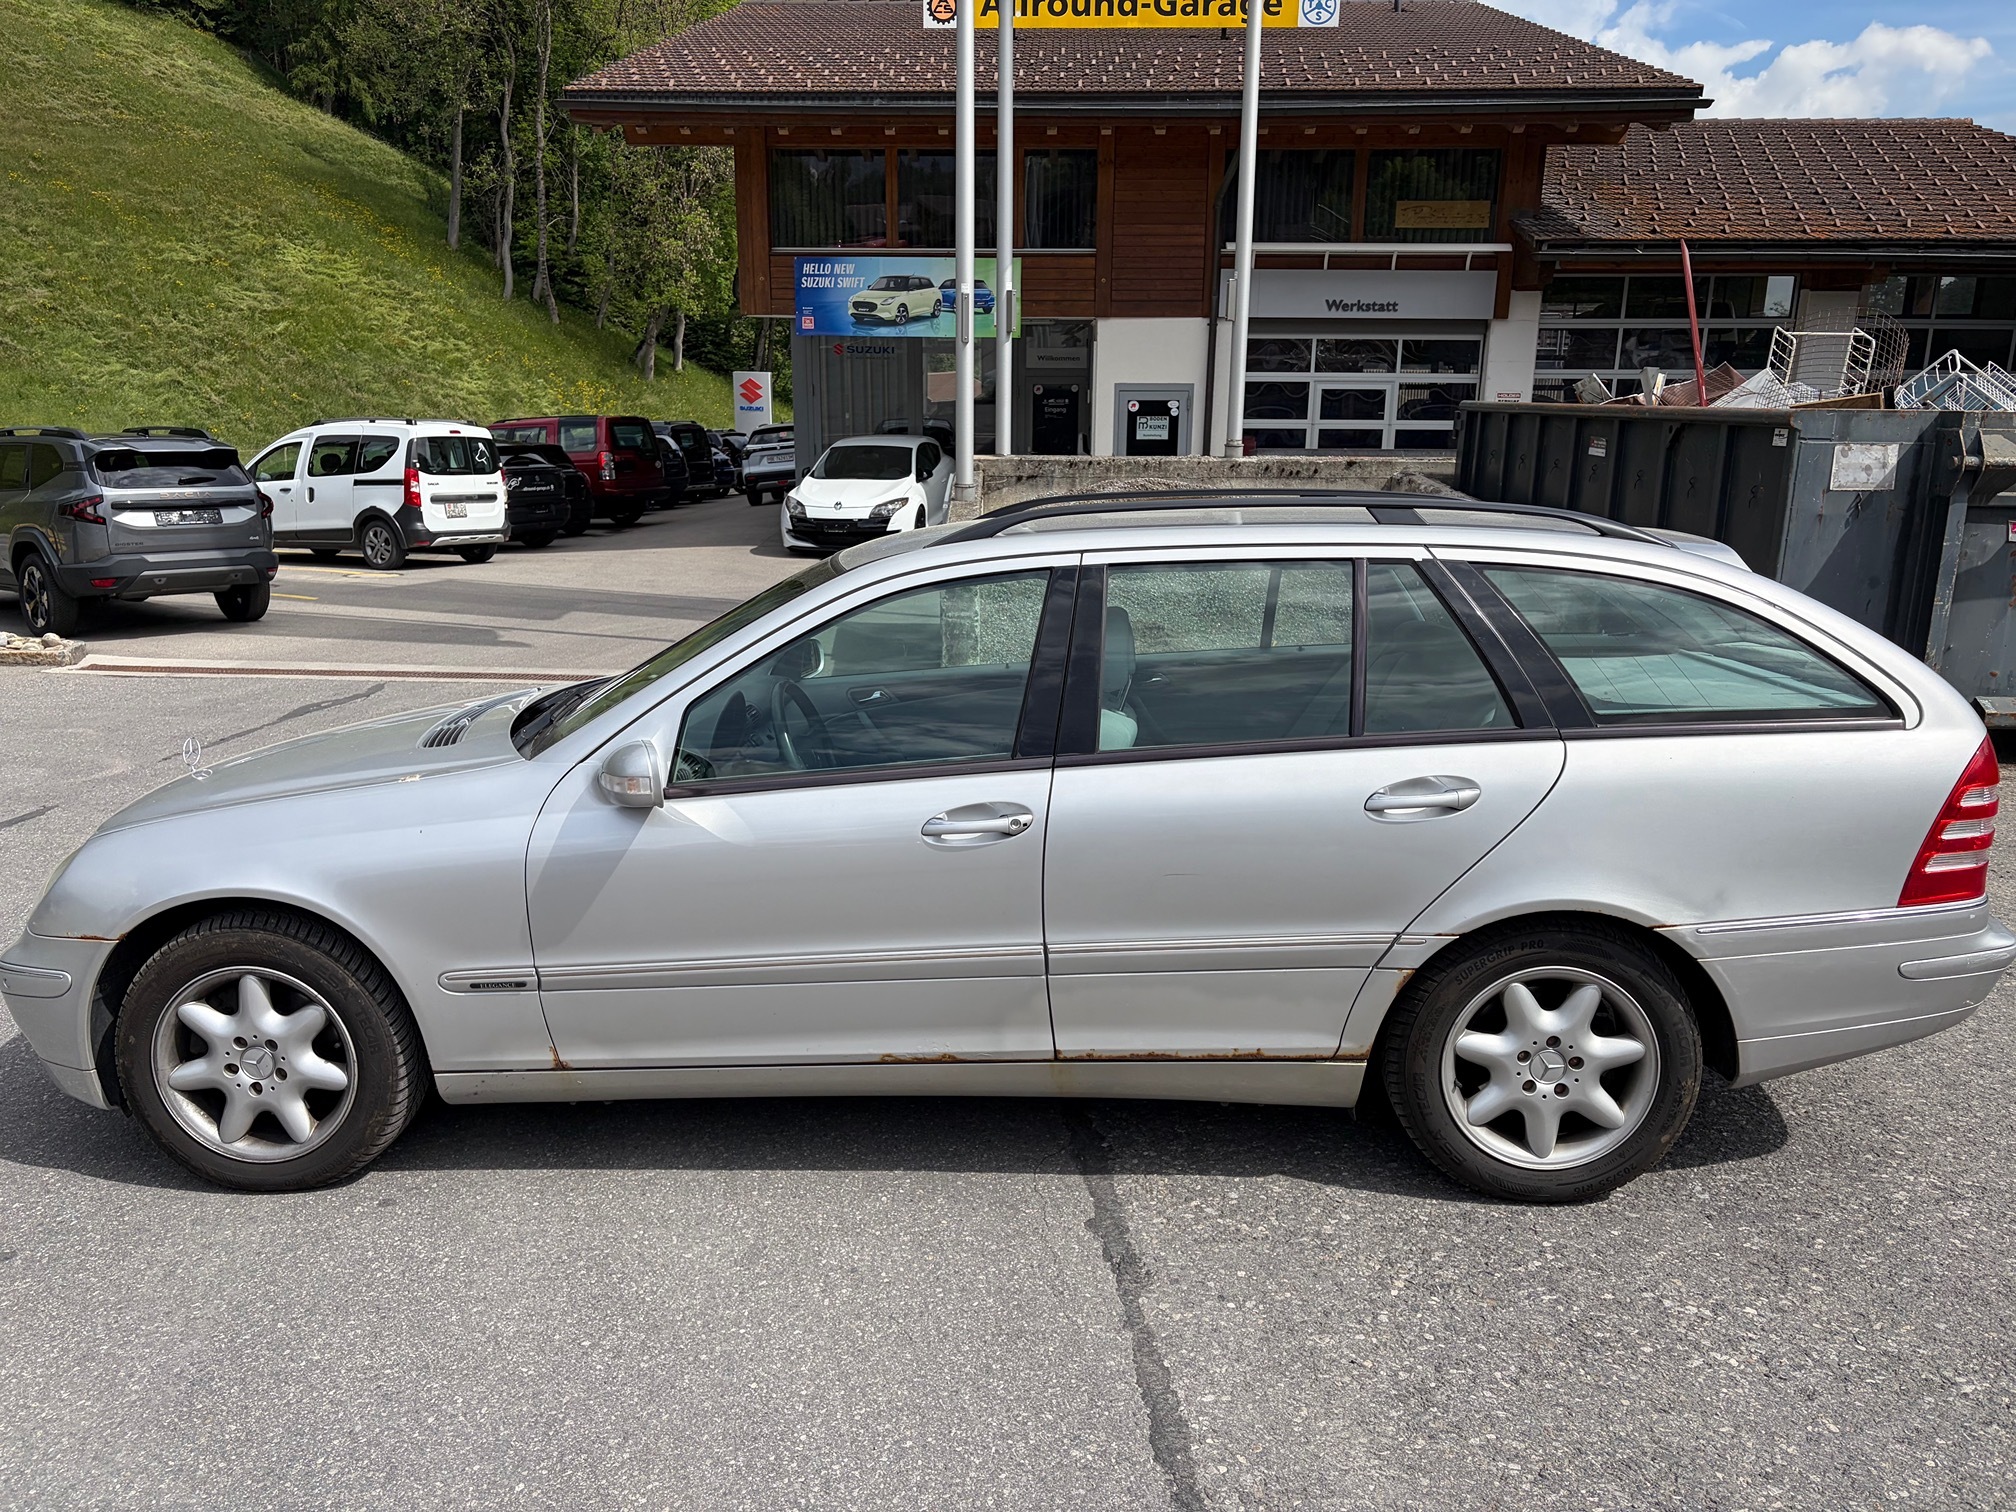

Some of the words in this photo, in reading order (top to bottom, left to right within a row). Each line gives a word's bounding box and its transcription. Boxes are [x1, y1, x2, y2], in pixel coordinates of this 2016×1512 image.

[980, 0, 1283, 24] Alround-Garae
[802, 263, 832, 275] HELLO
[834, 263, 855, 275] NEW
[801, 276, 835, 288] SUZUKI
[837, 276, 865, 288] SWIFT
[1325, 298, 1399, 312] Werkstatt
[846, 345, 895, 354] SUZUKI
[1044, 406, 1067, 414] Eingang
[1455, 945, 1516, 986] SUPERGRIP
[1520, 939, 1545, 952] PRO
[1598, 1161, 1638, 1188] 205/55
[1573, 1183, 1595, 1196] R16
